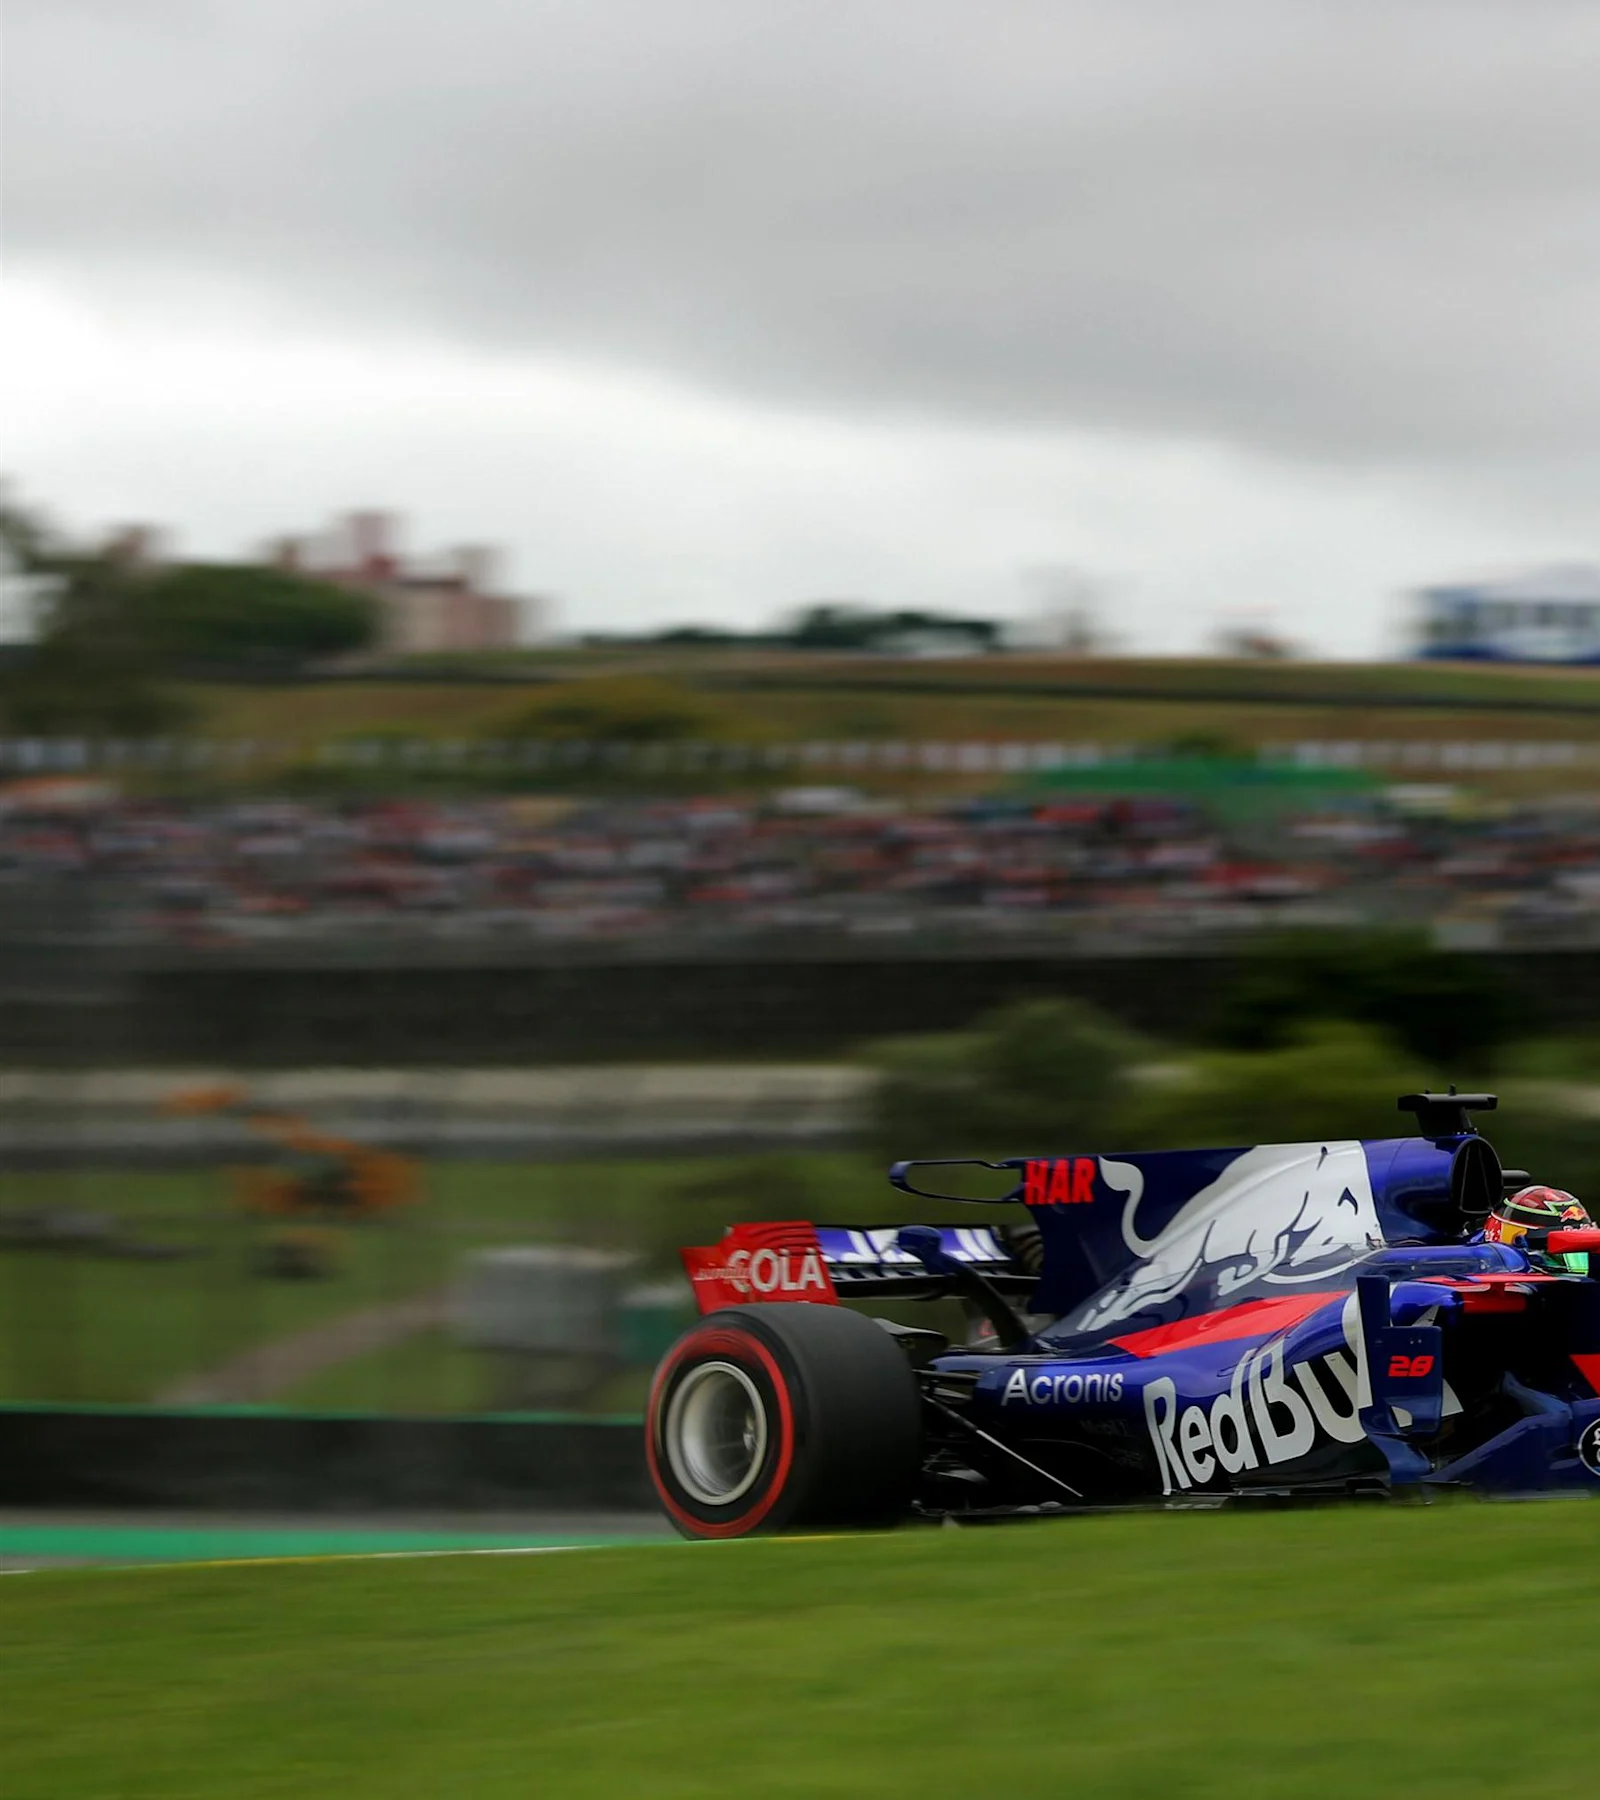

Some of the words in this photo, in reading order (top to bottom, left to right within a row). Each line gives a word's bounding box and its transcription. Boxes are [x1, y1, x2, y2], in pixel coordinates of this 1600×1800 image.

[1023, 1157, 1096, 1206] HAR
[727, 1247, 827, 1294] COLA
[1000, 1368, 1124, 1407] Acronis
[1387, 1354, 1435, 1378] 28
